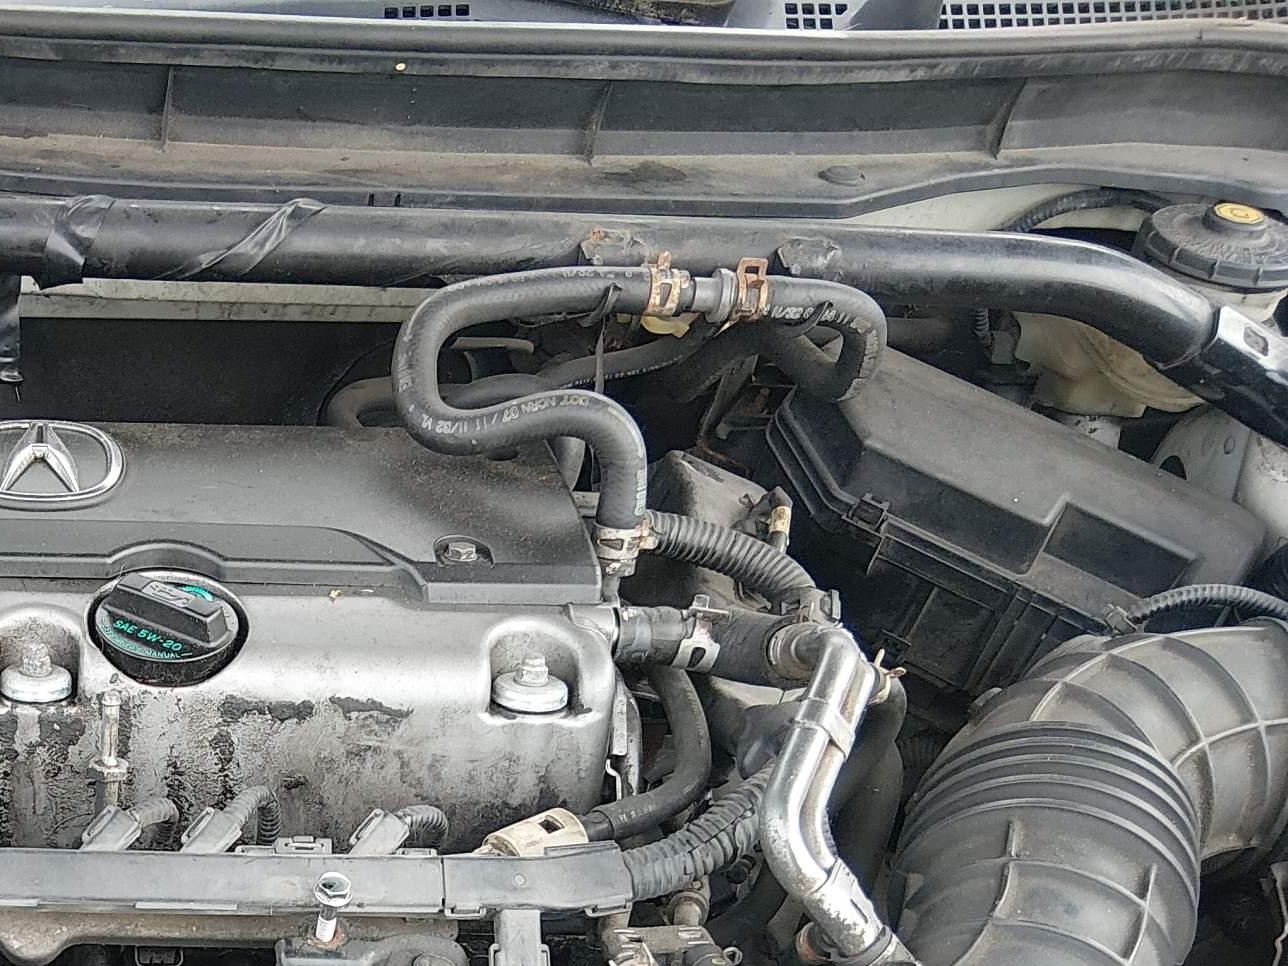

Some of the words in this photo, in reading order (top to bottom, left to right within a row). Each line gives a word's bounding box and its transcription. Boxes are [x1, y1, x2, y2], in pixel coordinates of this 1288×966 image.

[112, 618, 138, 634] SAE
[137, 628, 183, 652] 5W-20
[144, 649, 181, 659] MANUAL
